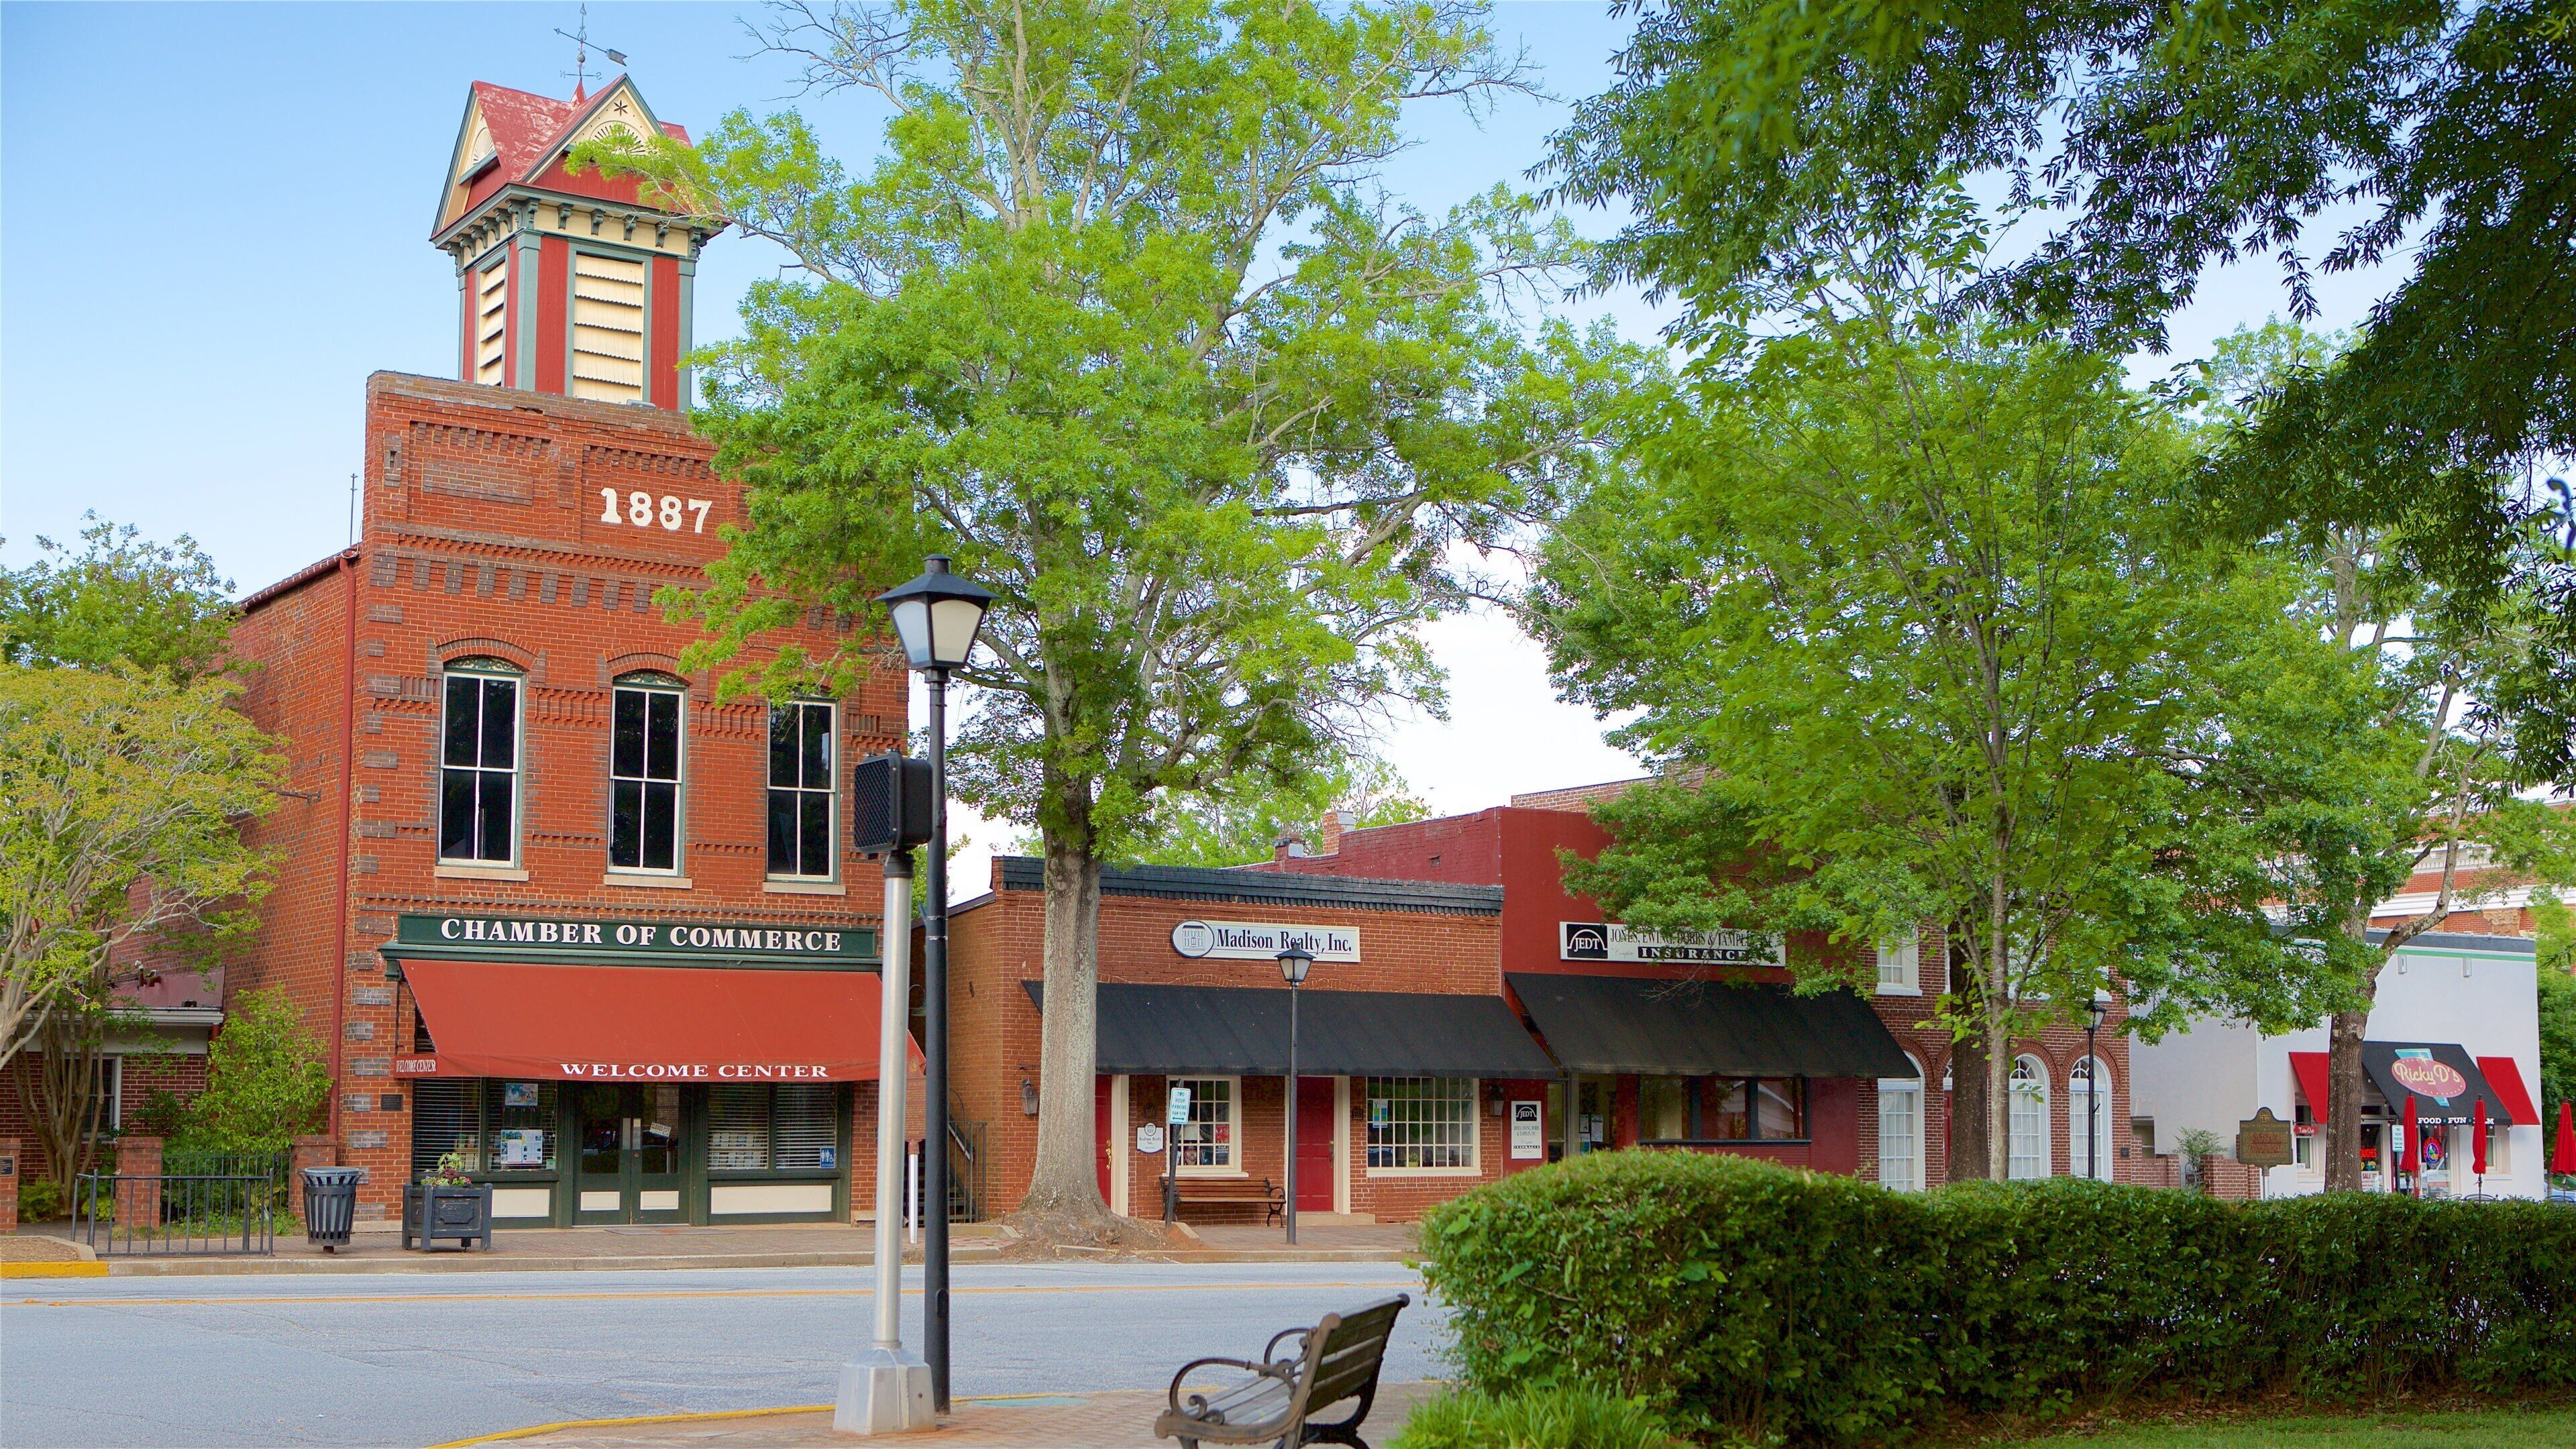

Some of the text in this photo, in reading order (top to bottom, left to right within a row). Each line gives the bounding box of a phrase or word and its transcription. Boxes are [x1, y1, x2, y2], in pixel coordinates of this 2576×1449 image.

[600, 487, 712, 534] 1887
[440, 918, 841, 951] CHAMBER OF COMMERCE
[1216, 928, 1352, 955] Madison Realty, Inc.
[1707, 932, 1715, 945] &
[1574, 937, 1600, 953] JEDT
[396, 1059, 437, 1073] WELCOME CENTER
[560, 1063, 829, 1078] WELCOME CENTER
[2392, 1063, 2461, 1085] Ricky D's
